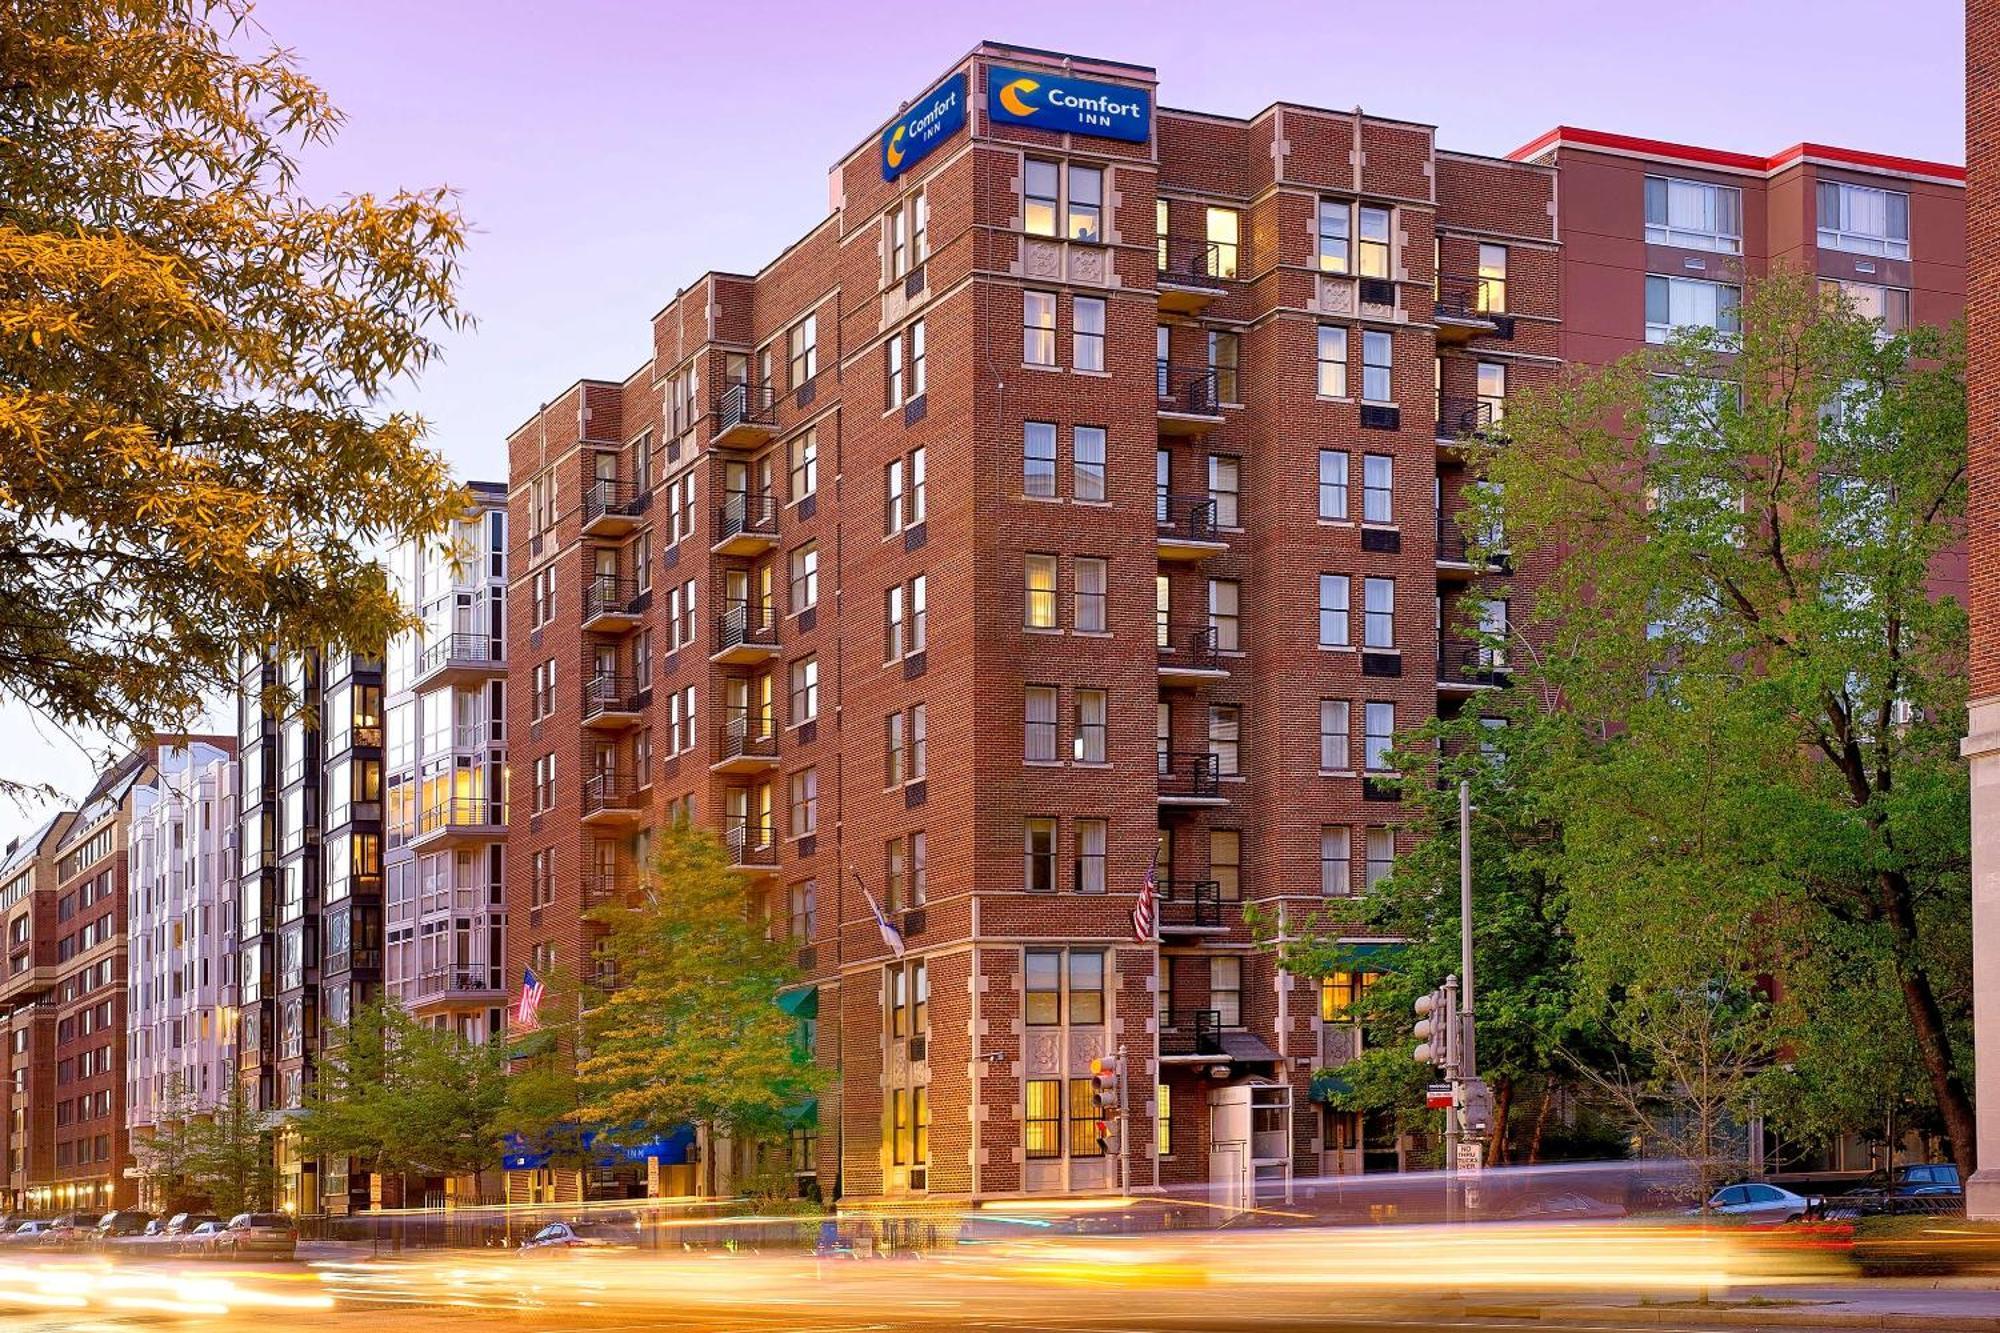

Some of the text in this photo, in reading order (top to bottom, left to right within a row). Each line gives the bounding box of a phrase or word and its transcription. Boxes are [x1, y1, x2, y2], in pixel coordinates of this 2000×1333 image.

[909, 91, 956, 138] Comfort
[1048, 88, 1140, 118] Comfort
[923, 121, 941, 141] INN
[1079, 113, 1110, 127] INN
